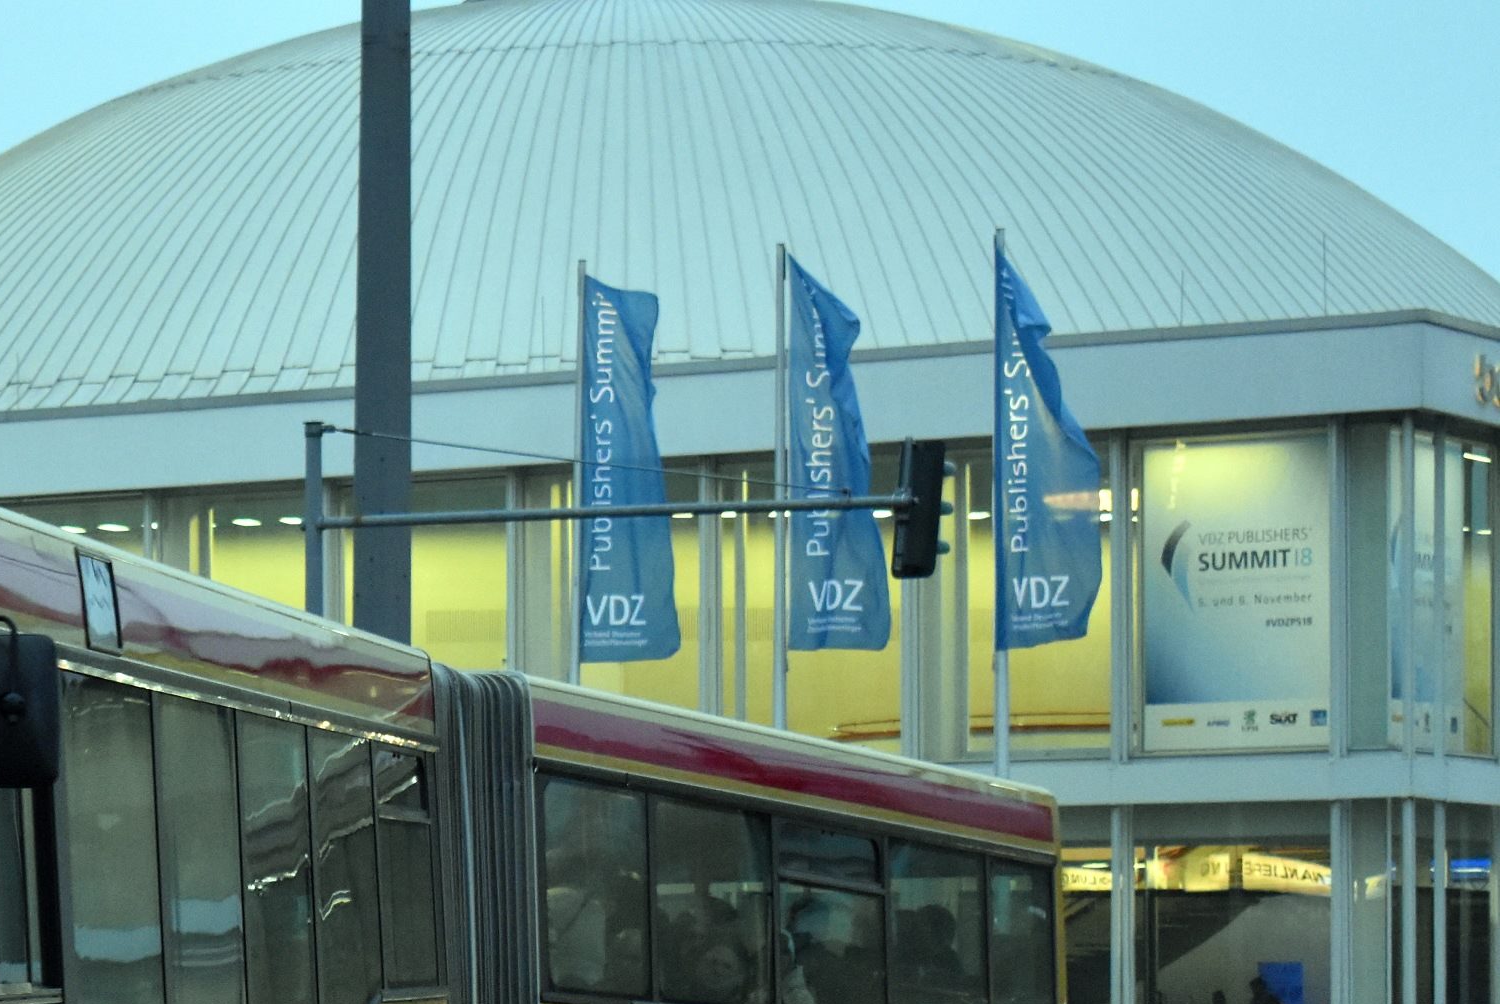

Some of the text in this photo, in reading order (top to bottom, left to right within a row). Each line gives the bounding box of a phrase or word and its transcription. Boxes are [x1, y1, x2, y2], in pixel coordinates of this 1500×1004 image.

[1004, 388, 1029, 553] Publishers'
[589, 414, 612, 571] Pubishers'
[808, 579, 864, 612] VDZ
[1013, 575, 1069, 609] VDZ
[1254, 592, 1312, 605] November
[586, 595, 647, 626] VDZ
